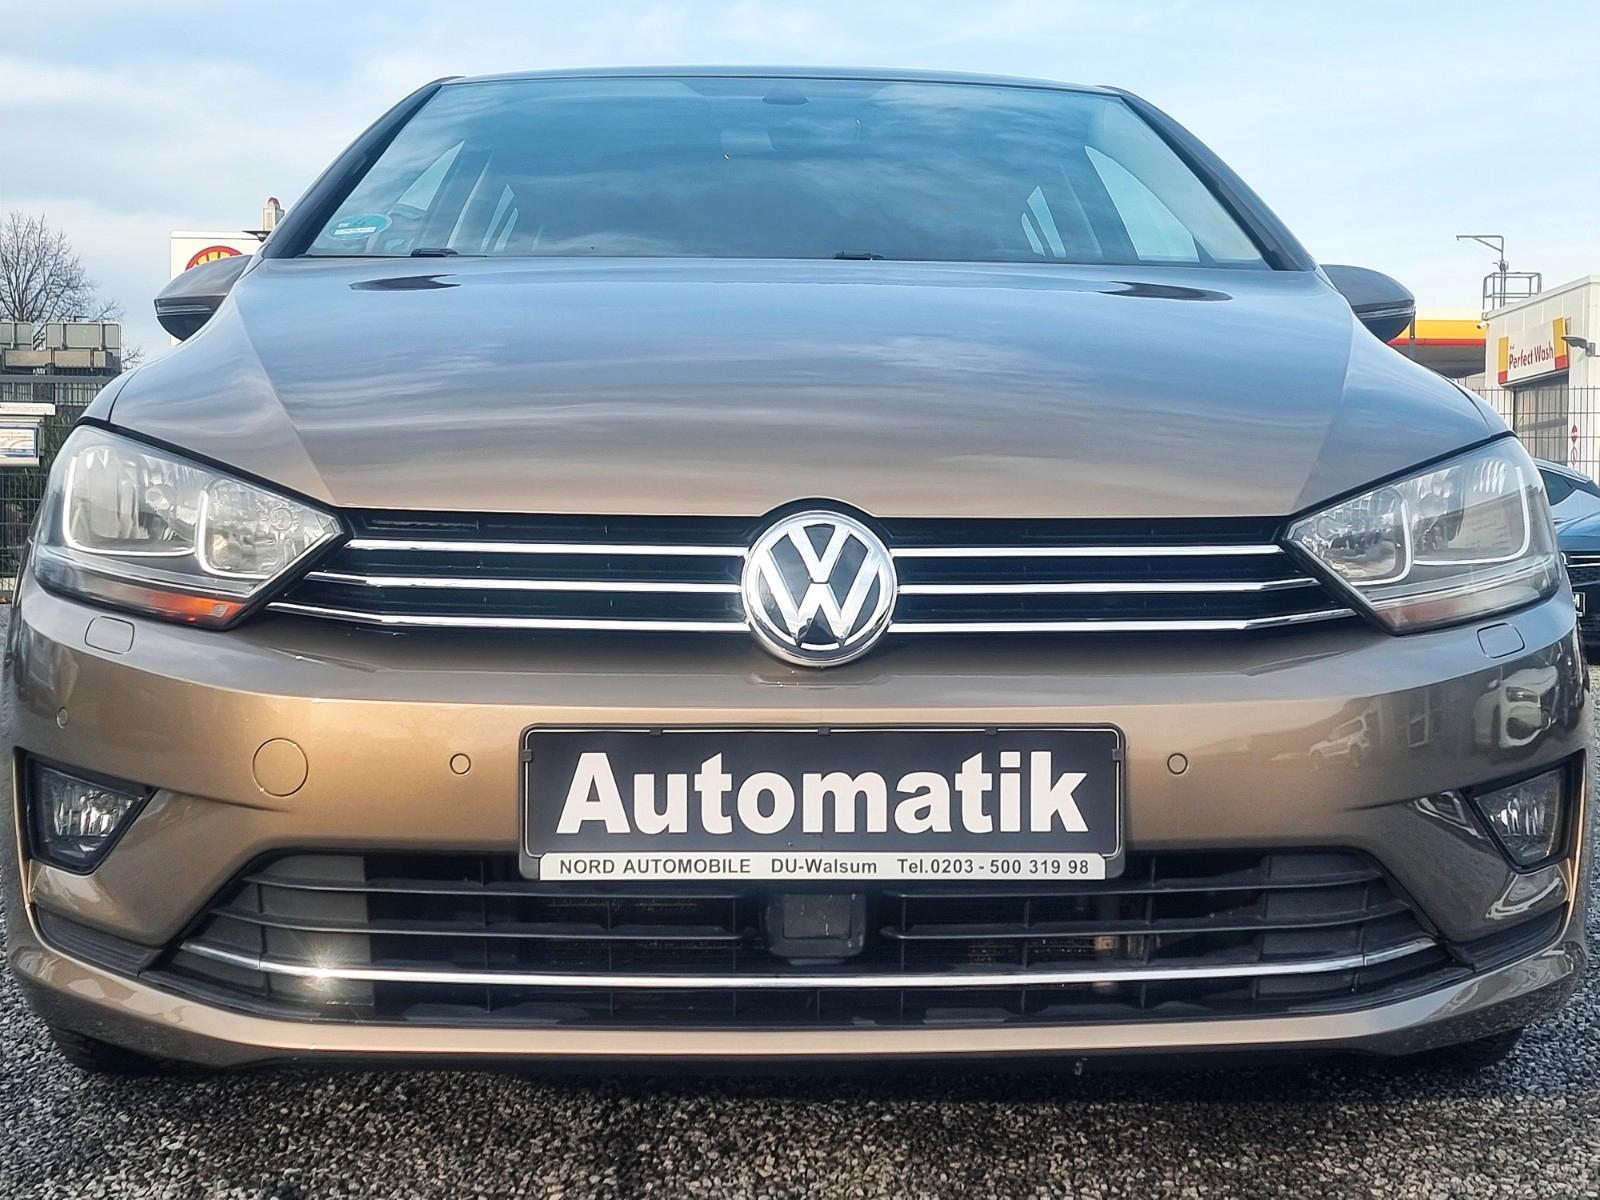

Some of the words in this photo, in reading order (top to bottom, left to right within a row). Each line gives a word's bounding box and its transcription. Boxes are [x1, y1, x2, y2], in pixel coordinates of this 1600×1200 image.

[1509, 348, 1533, 370] Perfect
[1534, 340, 1553, 363] Wash
[746, 517, 889, 654] VW
[556, 751, 1088, 834] Automatik
[560, 859, 615, 874] NORD
[623, 858, 751, 873] AUTOMOBILE
[771, 858, 877, 874] DU-Walsum
[990, 858, 1022, 874] 500
[1029, 858, 1061, 874] 319
[1068, 858, 1089, 874] 98
